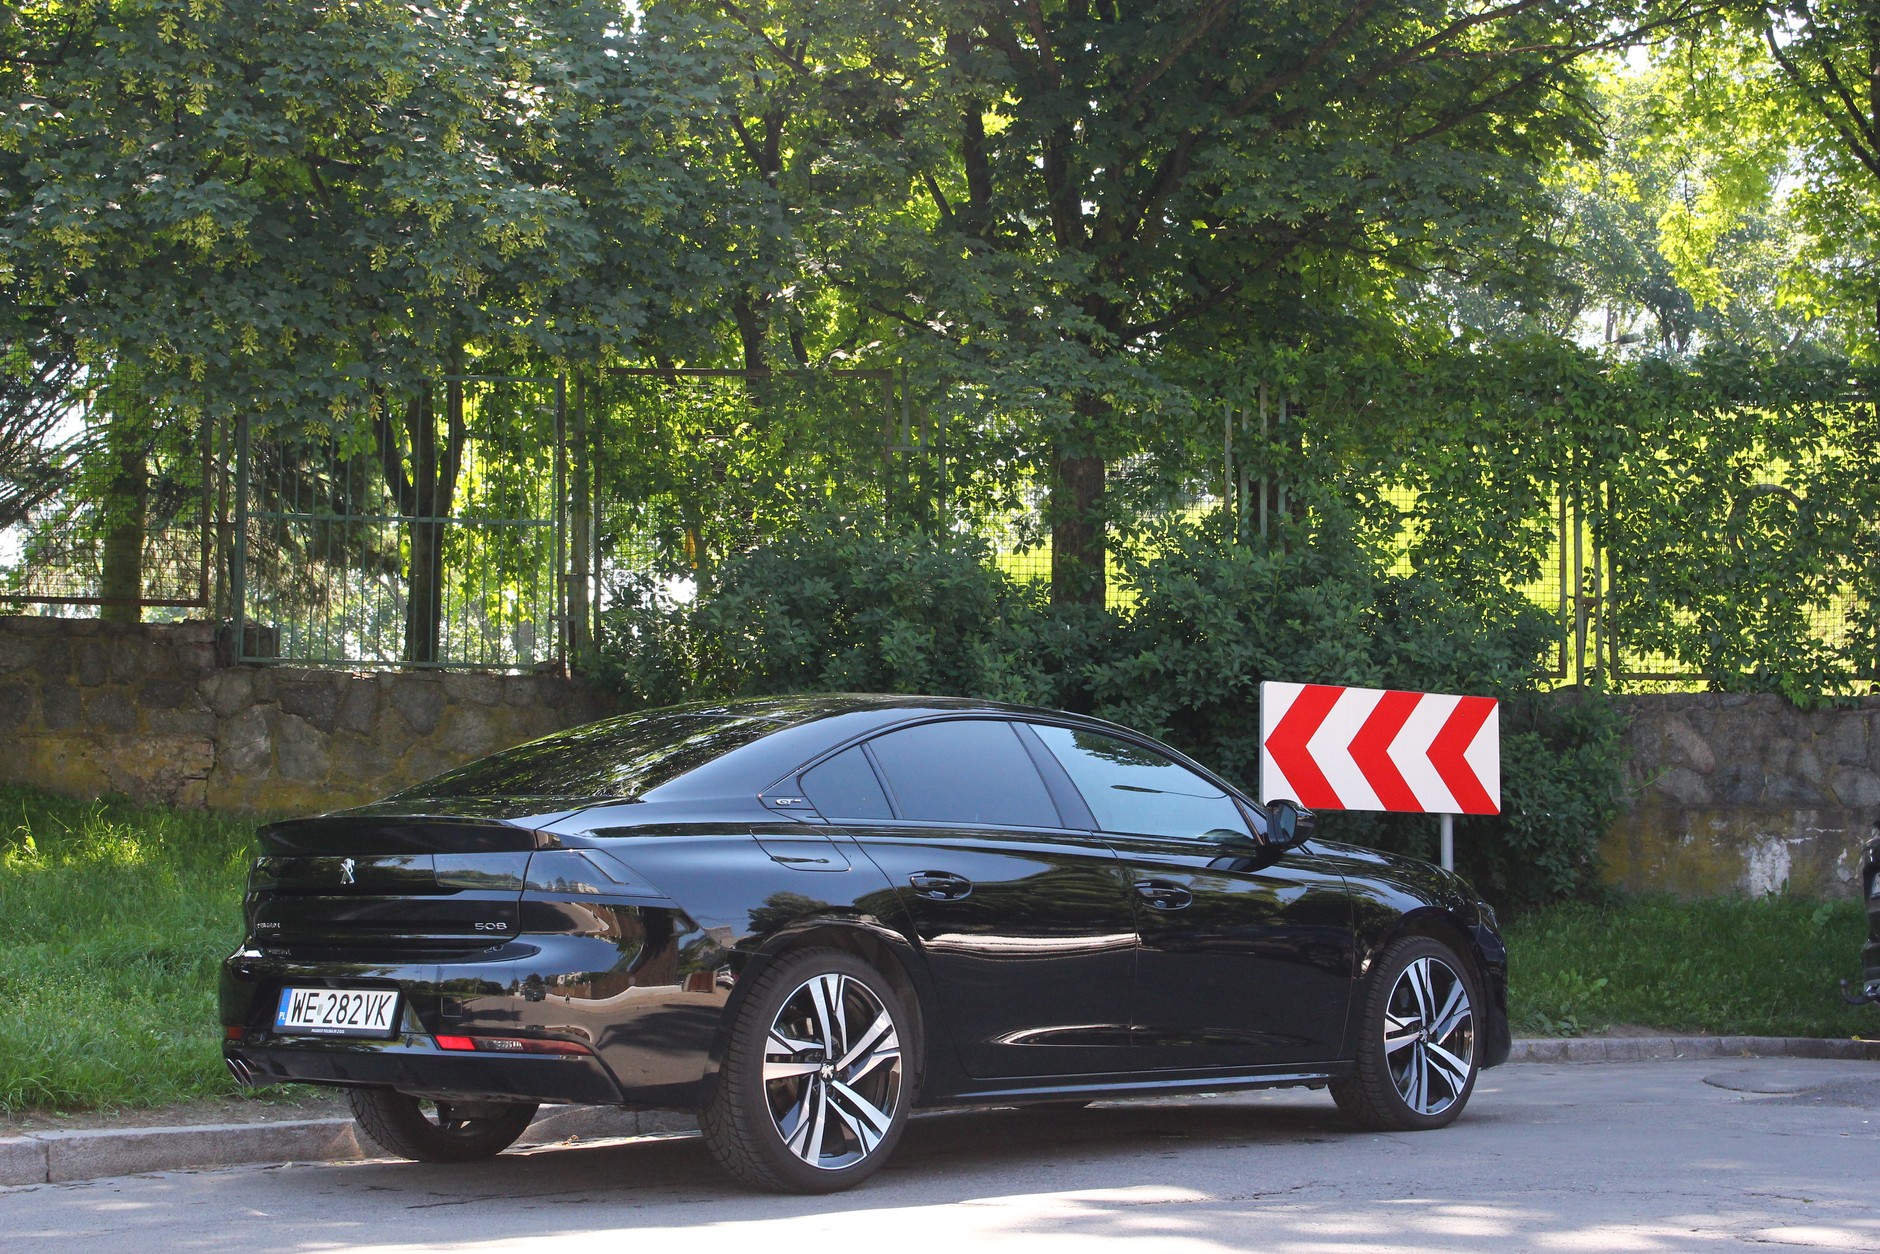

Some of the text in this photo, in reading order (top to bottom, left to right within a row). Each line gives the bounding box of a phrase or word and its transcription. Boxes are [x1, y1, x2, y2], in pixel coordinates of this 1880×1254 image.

[776, 798, 793, 806] GT
[474, 922, 508, 930] 508
[290, 992, 393, 1027] WE 282VK
[278, 1011, 286, 1020] PL
